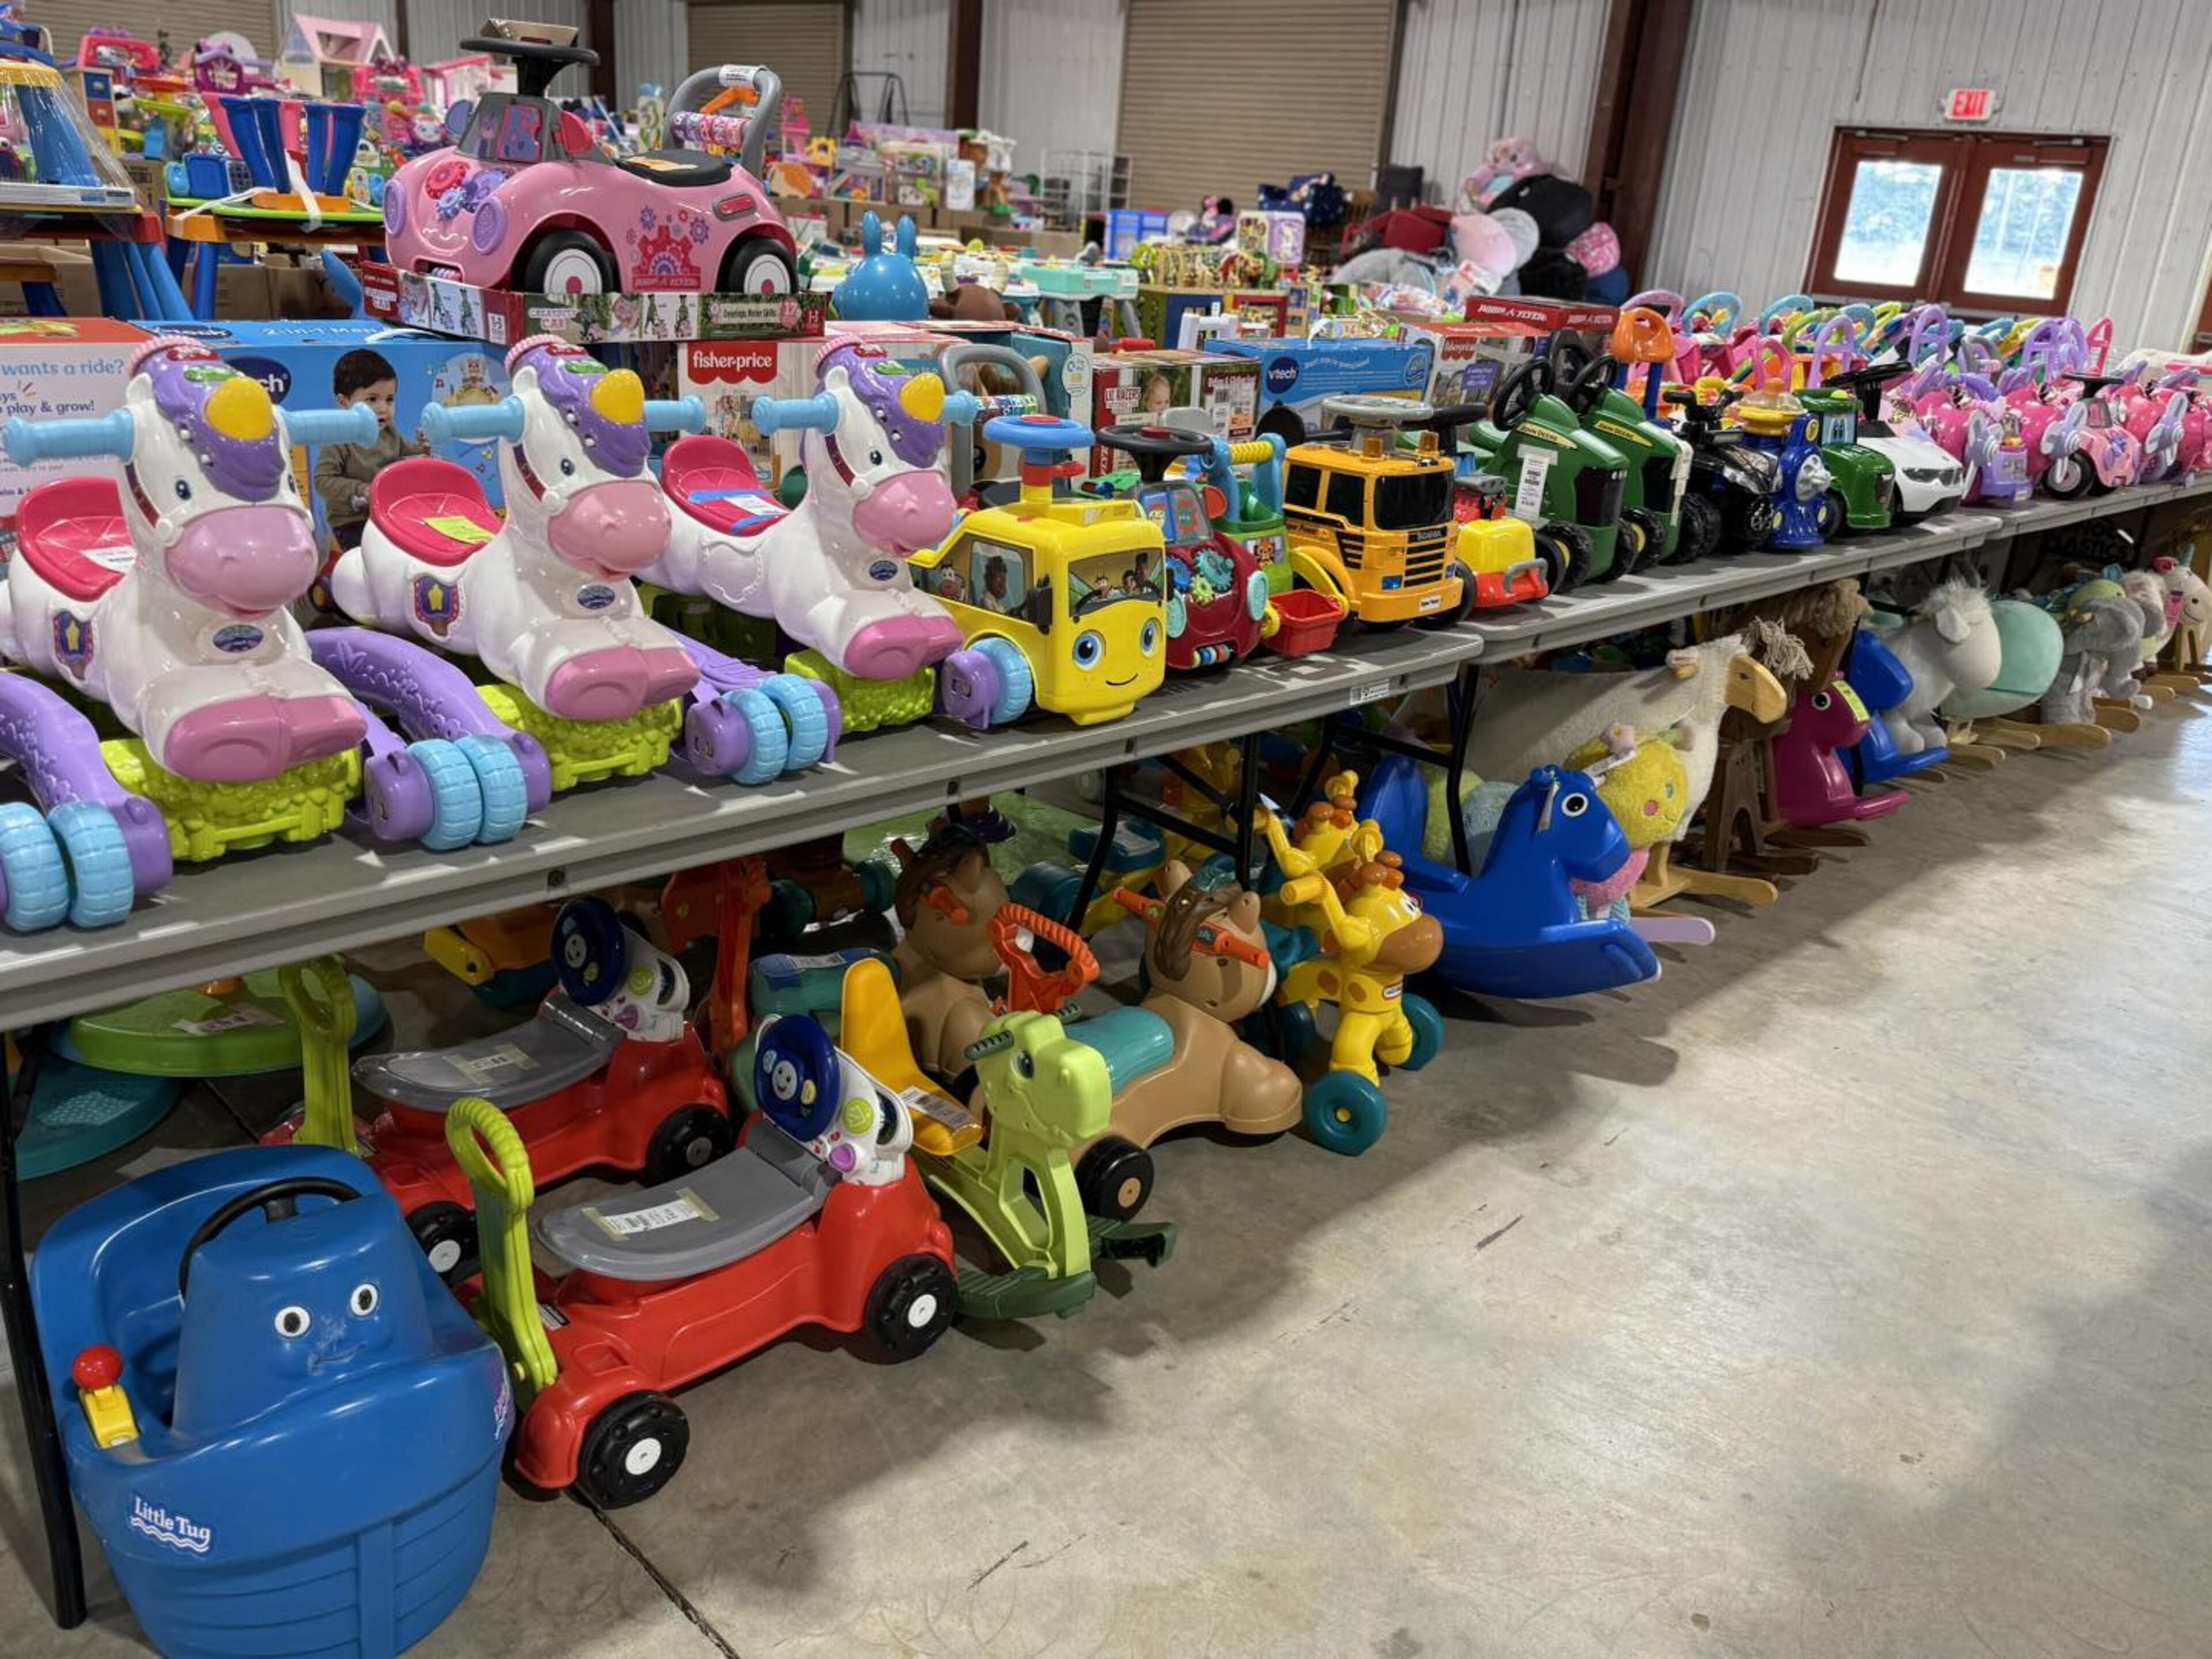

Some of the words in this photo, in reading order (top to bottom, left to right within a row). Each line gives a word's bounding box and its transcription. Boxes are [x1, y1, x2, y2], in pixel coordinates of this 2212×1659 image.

[2, 362, 58, 375] wants
[64, 365, 74, 375] a
[82, 359, 124, 374] ride?
[693, 350, 772, 372] fisher-price
[1268, 366, 1296, 380] vtech
[7, 402, 36, 416] play
[56, 400, 95, 415] grow!
[134, 1496, 173, 1531] Little
[175, 1515, 211, 1547] Tug
